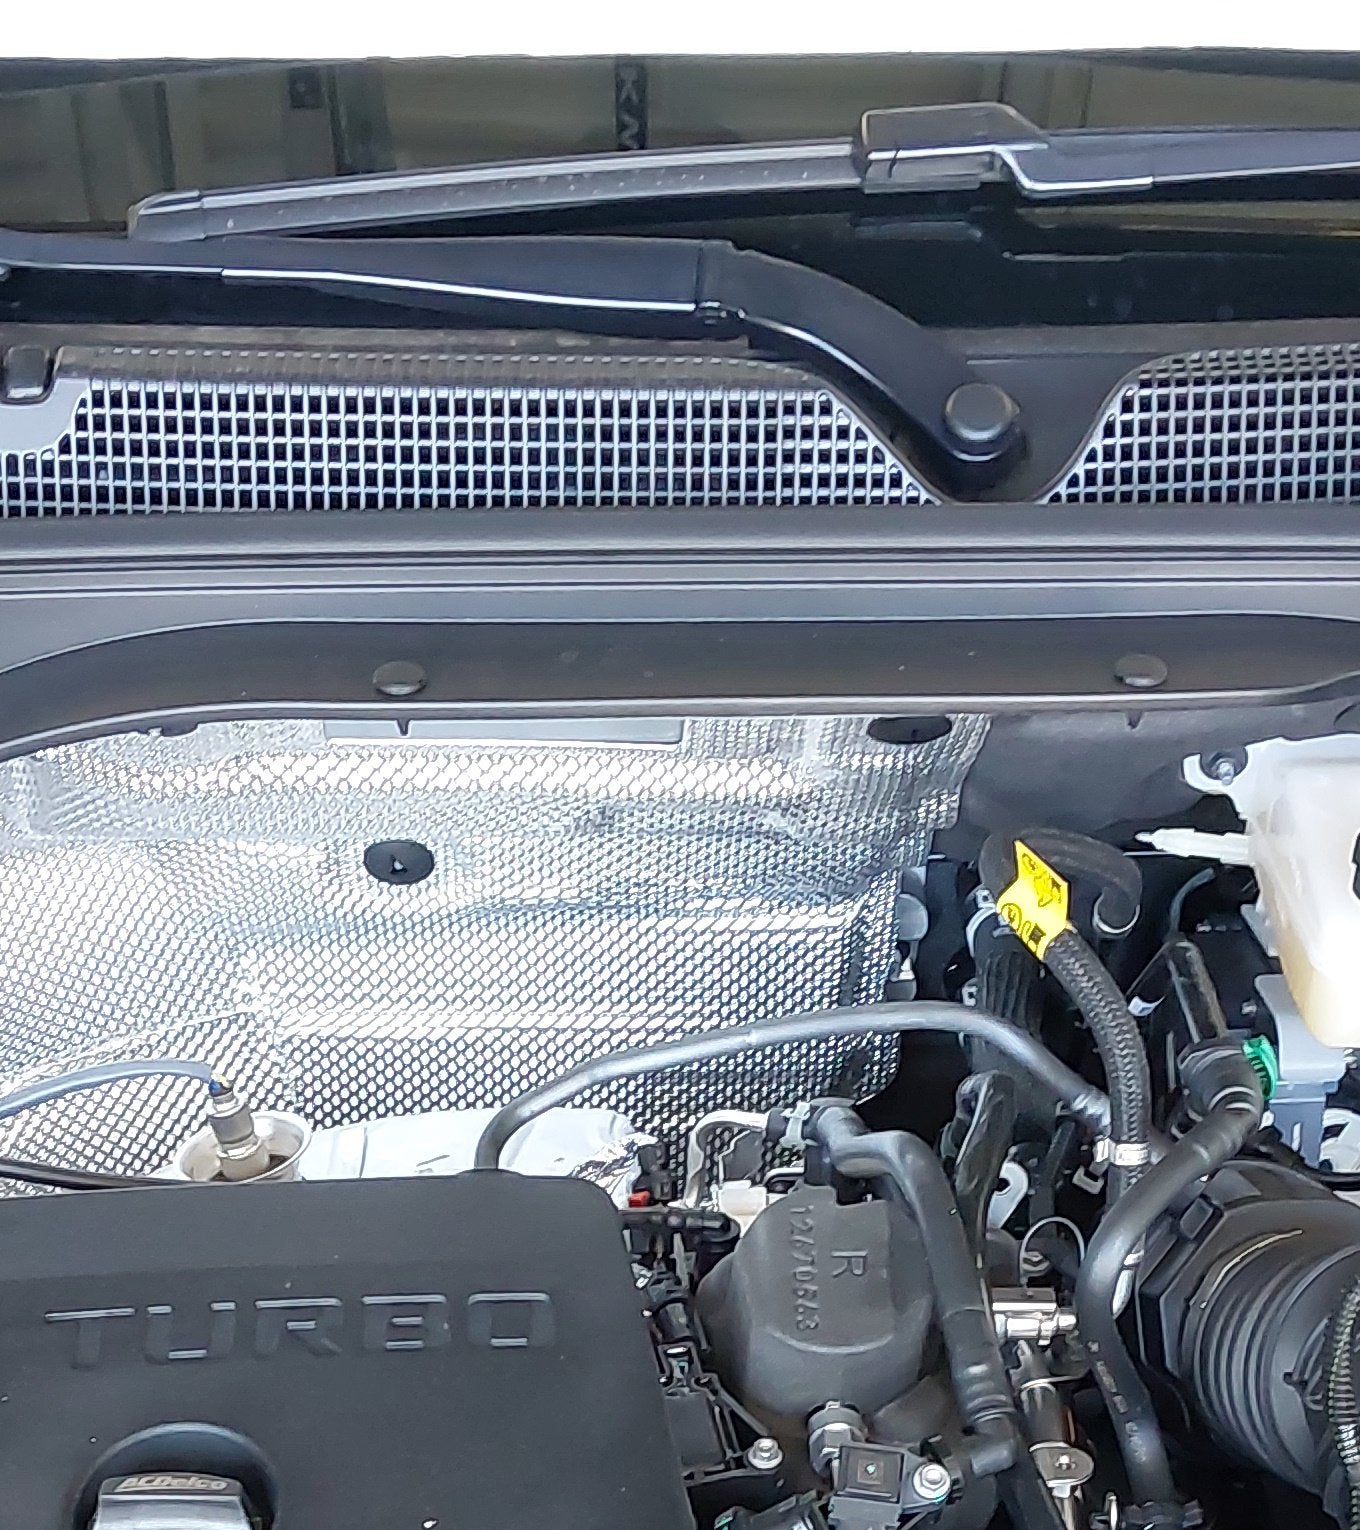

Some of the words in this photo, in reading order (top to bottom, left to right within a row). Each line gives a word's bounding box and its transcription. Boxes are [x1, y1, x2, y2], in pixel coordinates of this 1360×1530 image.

[831, 1250, 869, 1278] R
[43, 1292, 557, 1370] TURBO
[113, 1476, 229, 1493] ACDelco
